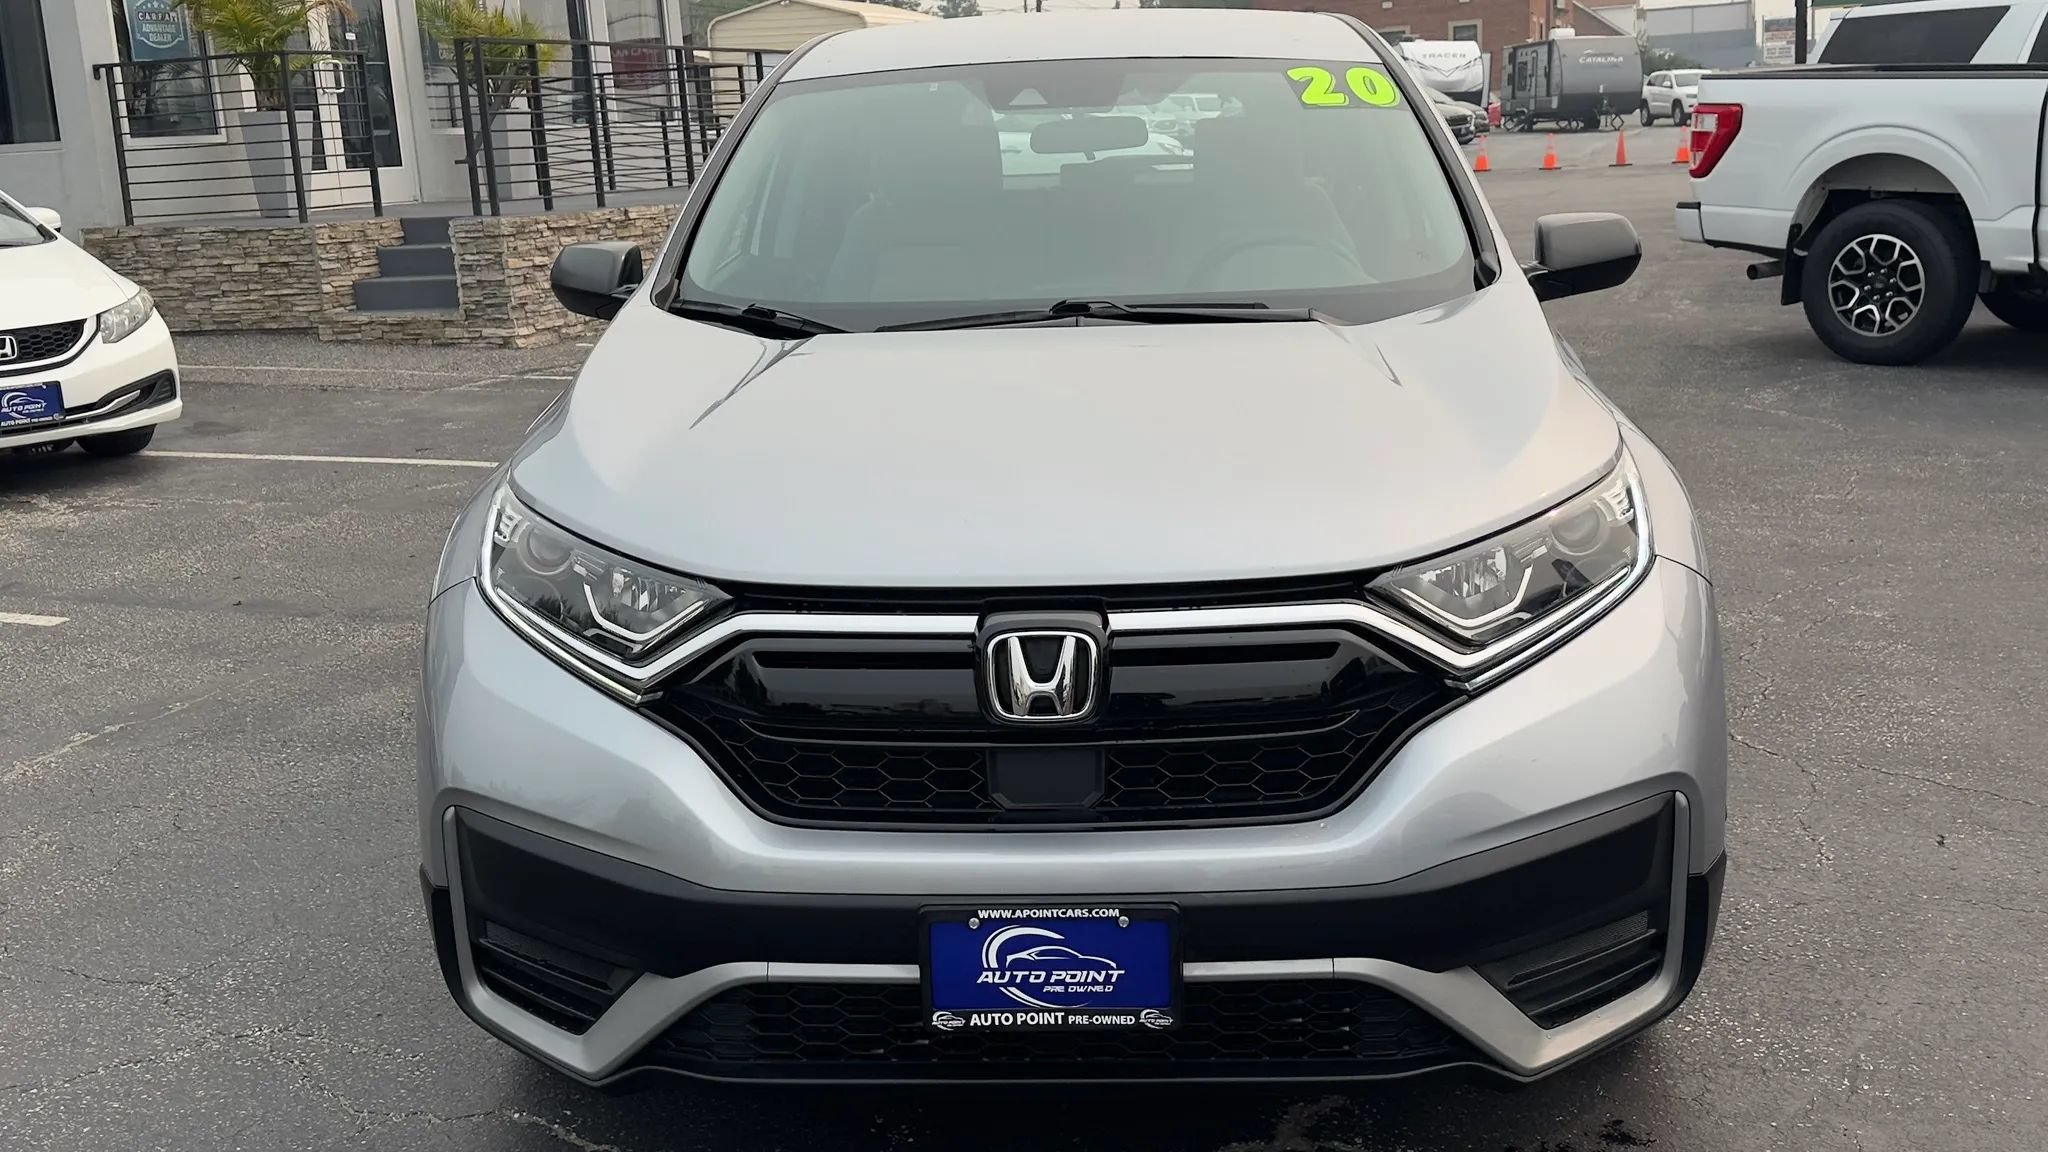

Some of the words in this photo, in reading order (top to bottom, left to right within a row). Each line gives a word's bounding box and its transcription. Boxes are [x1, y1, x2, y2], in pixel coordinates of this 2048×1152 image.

[148, 33, 173, 42] DEALER
[1578, 55, 1625, 64] CATALINA
[1286, 66, 1400, 107] 20
[1, 404, 23, 413] AUTO
[24, 402, 47, 410] POINT
[978, 908, 1120, 919] WWW.APOINTCARS.COM
[976, 970, 1047, 983] AUTO
[1051, 970, 1125, 983] POINT
[1043, 985, 1065, 993] PRE
[1068, 985, 1114, 993] OWNED
[970, 1013, 1014, 1026] AUTO
[1016, 1012, 1065, 1025] POINT
[1068, 1015, 1136, 1025] PRE-OWNED
